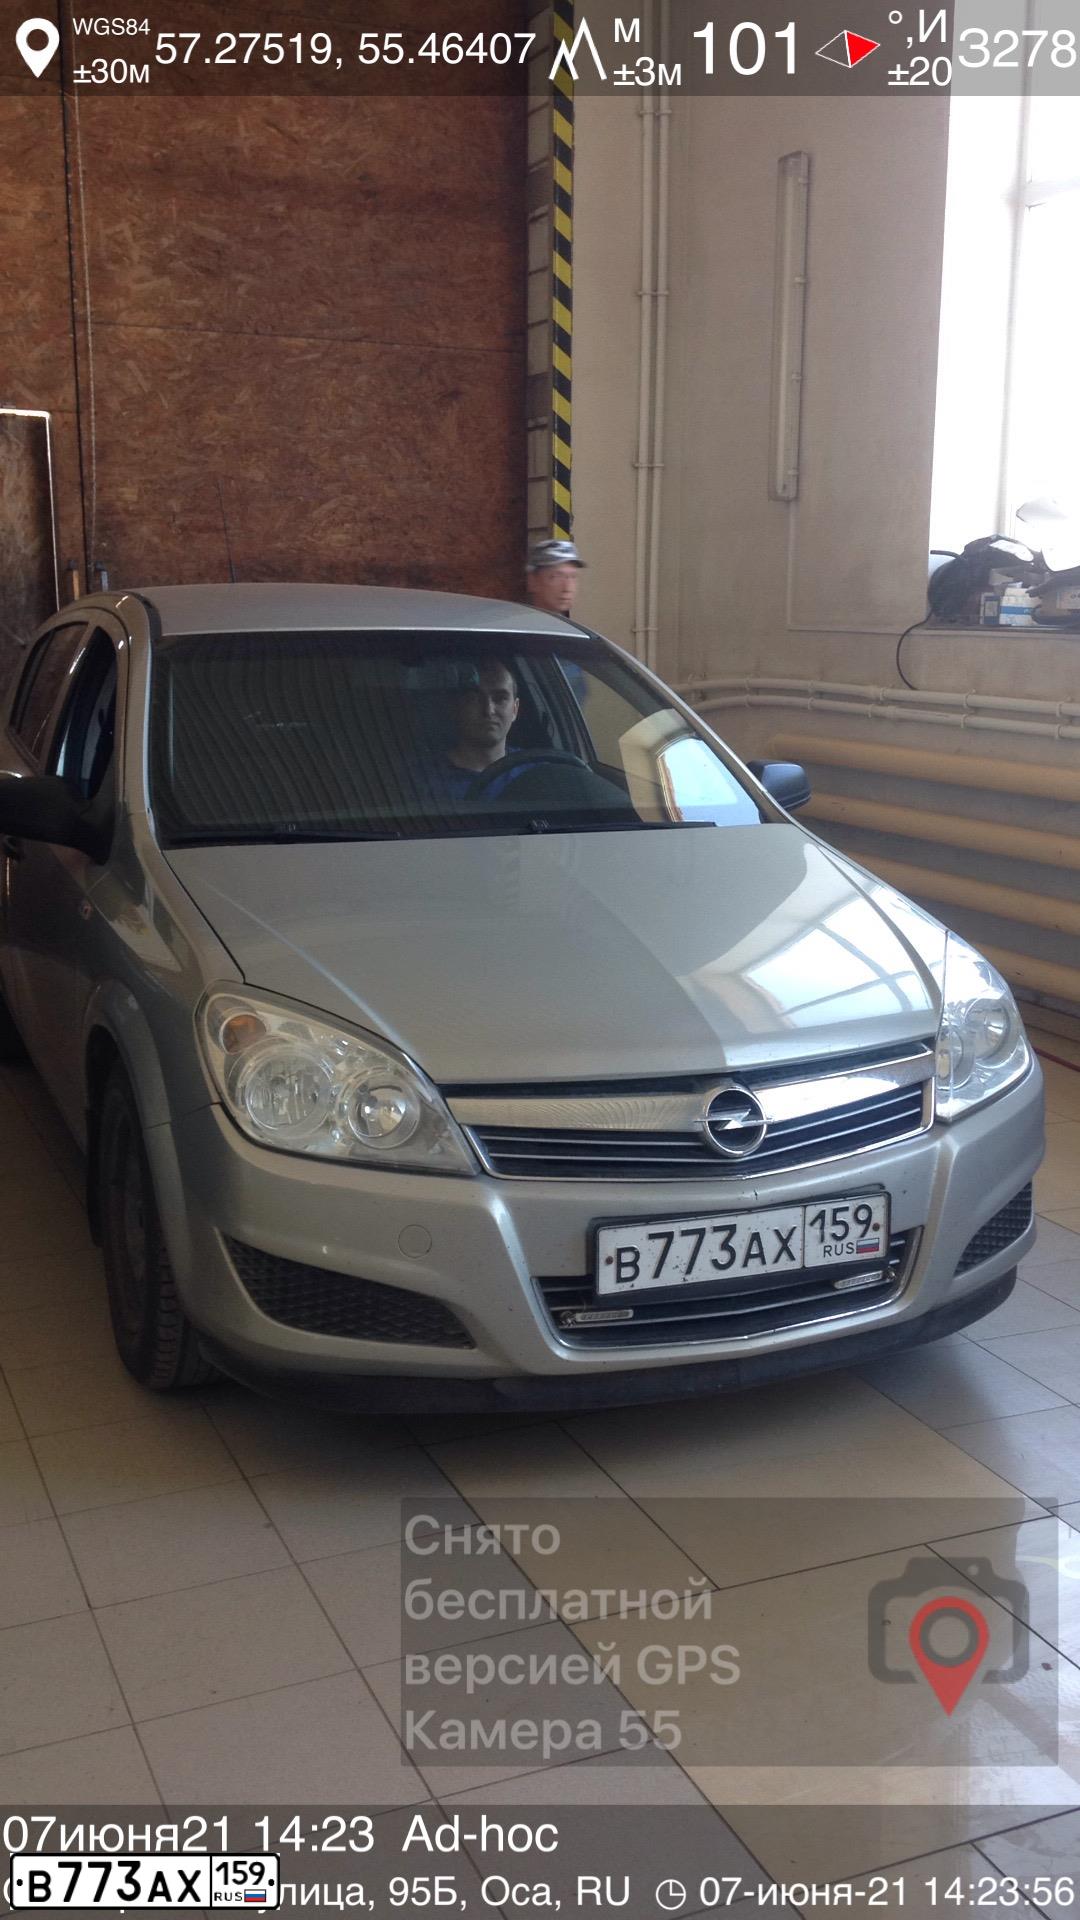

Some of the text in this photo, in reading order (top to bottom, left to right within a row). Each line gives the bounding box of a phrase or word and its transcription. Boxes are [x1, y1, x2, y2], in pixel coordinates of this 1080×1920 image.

[615, 1203, 873, 1284] В773АХ 159
[823, 1241, 856, 1257] RUS
